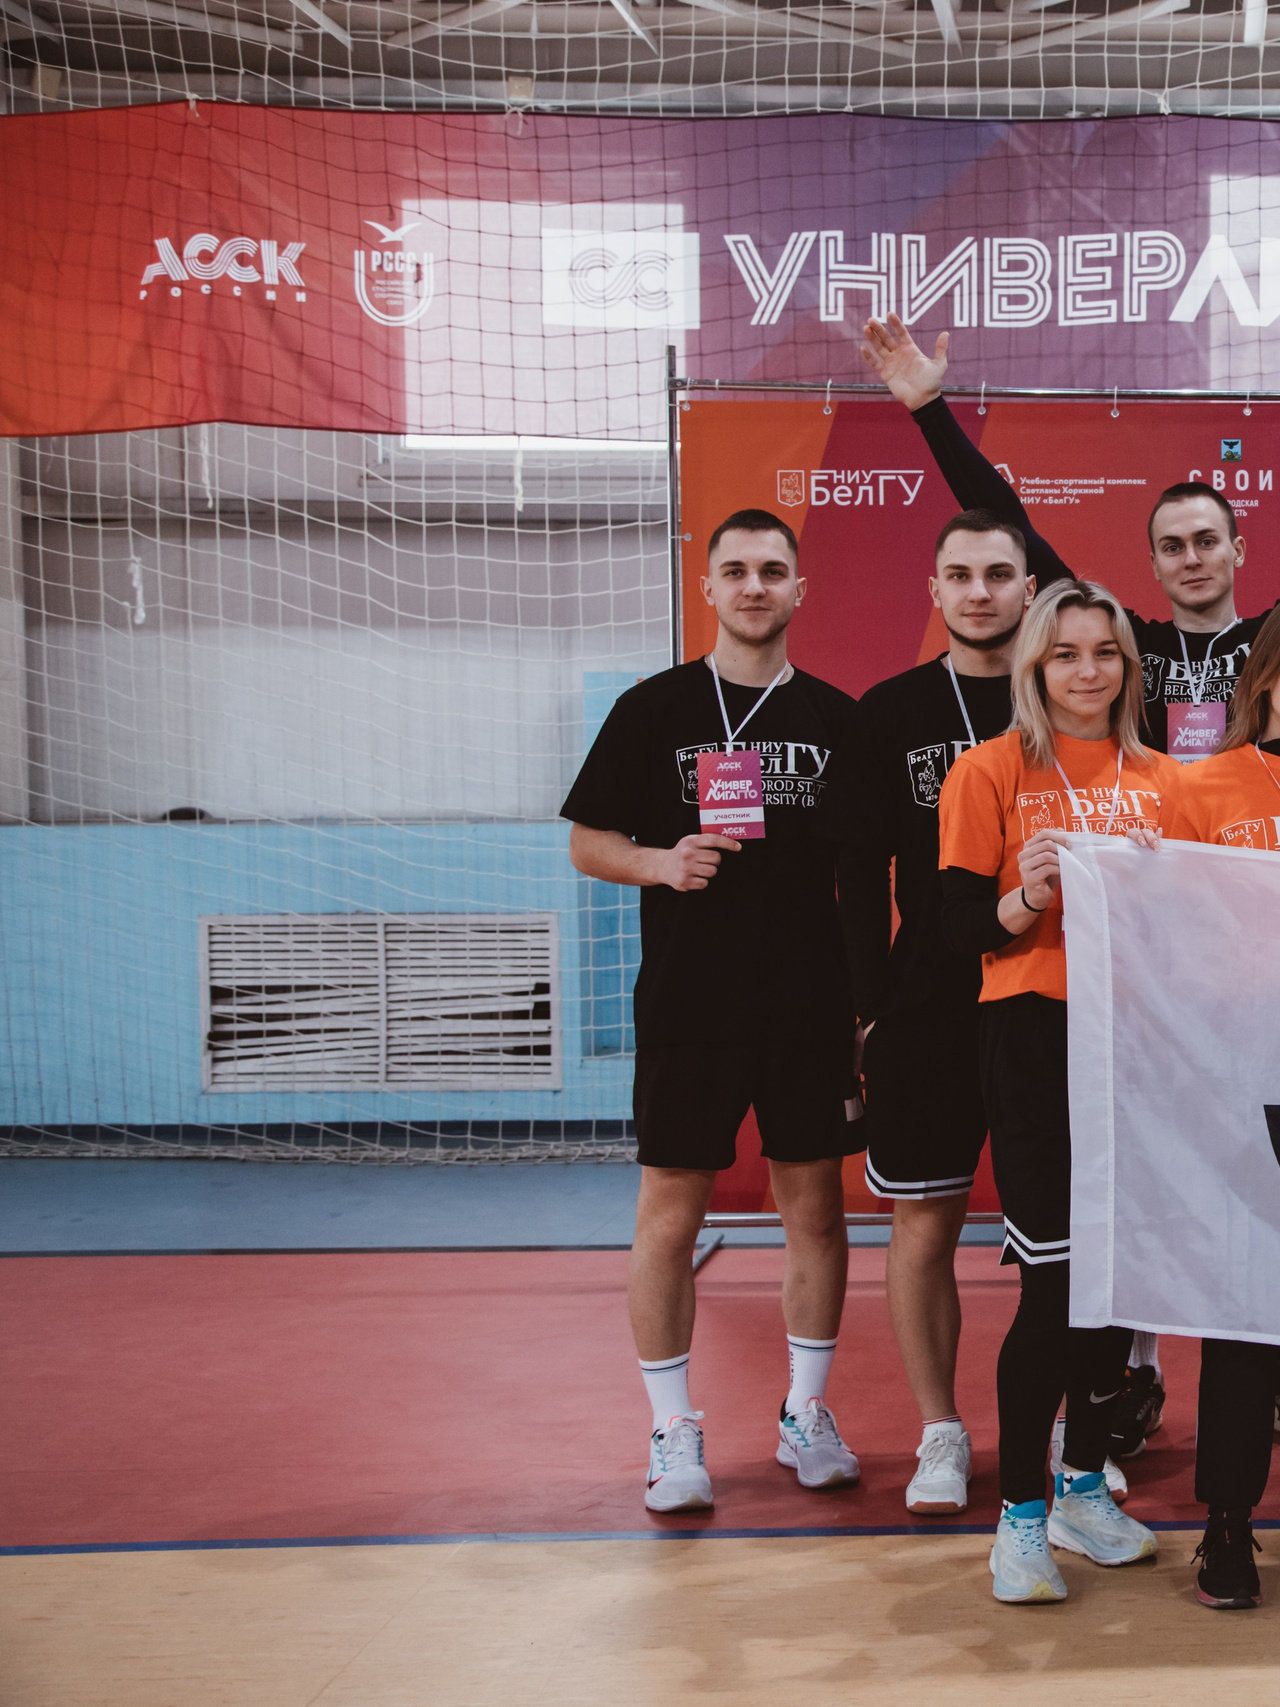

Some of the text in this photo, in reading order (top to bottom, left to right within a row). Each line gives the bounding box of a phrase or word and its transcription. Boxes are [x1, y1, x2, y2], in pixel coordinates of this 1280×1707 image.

[140, 232, 307, 287] АССК
[371, 250, 417, 273] РССС
[139, 283, 307, 303] РОССИИ
[833, 470, 873, 484] НИУ
[1020, 477, 1105, 486] Учебно-спортивный
[1188, 469, 1273, 491] СВОИ
[811, 475, 924, 506] БелГУ
[1020, 486, 1105, 495] Светланы Хоркиной
[1020, 496, 1041, 504] НИУ
[750, 741, 784, 753] НИУ
[909, 747, 942, 765] БелГУ
[709, 779, 753, 791] УНИВЕР
[1020, 793, 1056, 808] БелГУ
[1225, 822, 1261, 840] БелГУ
